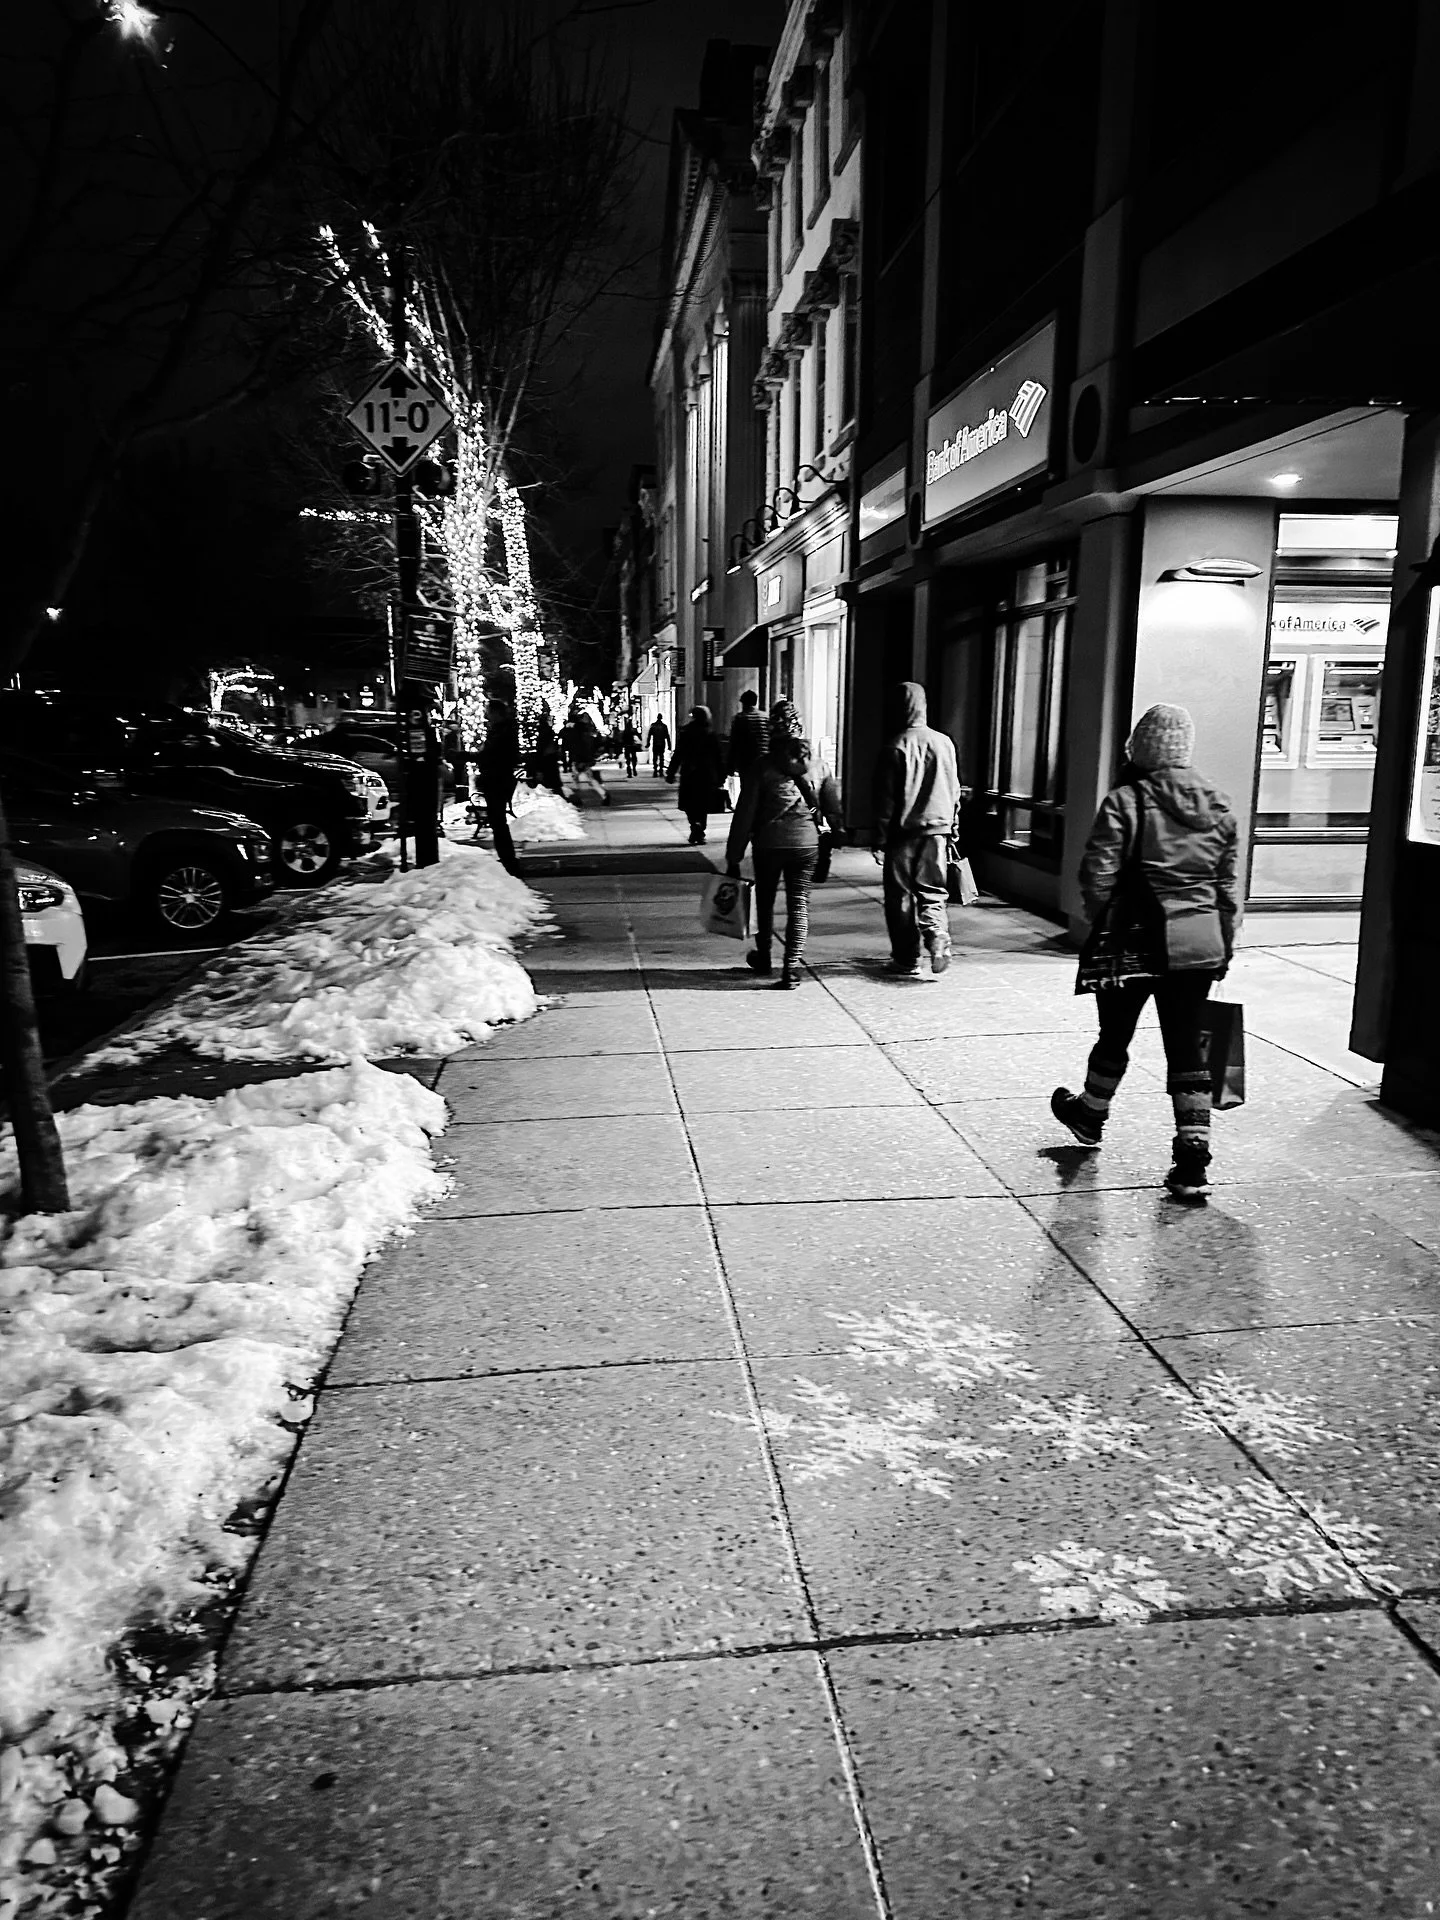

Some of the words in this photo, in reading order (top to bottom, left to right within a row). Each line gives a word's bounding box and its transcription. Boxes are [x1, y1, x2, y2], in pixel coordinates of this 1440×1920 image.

[927, 439, 951, 486] Bank
[950, 430, 963, 471] of
[960, 408, 1008, 465] America
[1293, 616, 1346, 632] America
